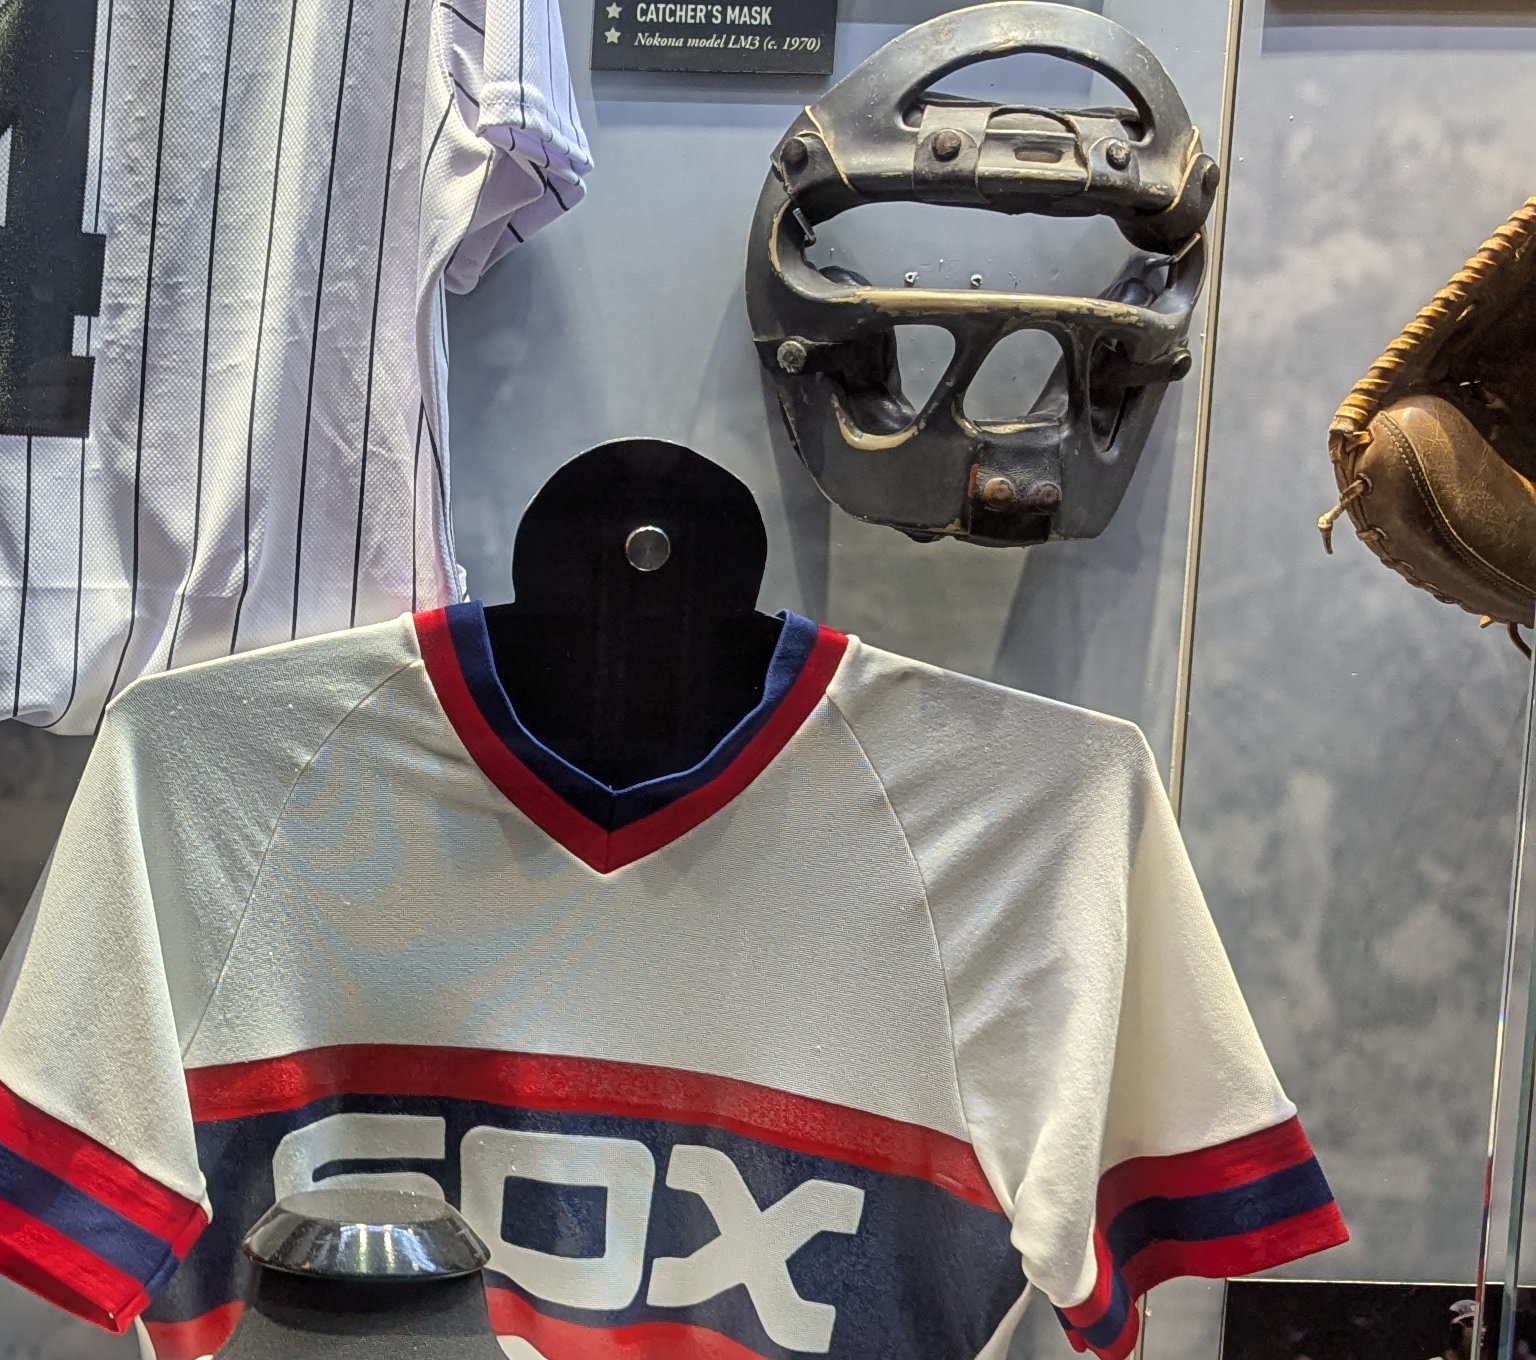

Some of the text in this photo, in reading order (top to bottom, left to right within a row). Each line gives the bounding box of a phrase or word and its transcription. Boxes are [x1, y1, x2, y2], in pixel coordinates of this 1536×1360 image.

[637, 3, 772, 26] CATCHER'S MASK
[634, 33, 821, 52] Nokona model LM3 (c. 1970)
